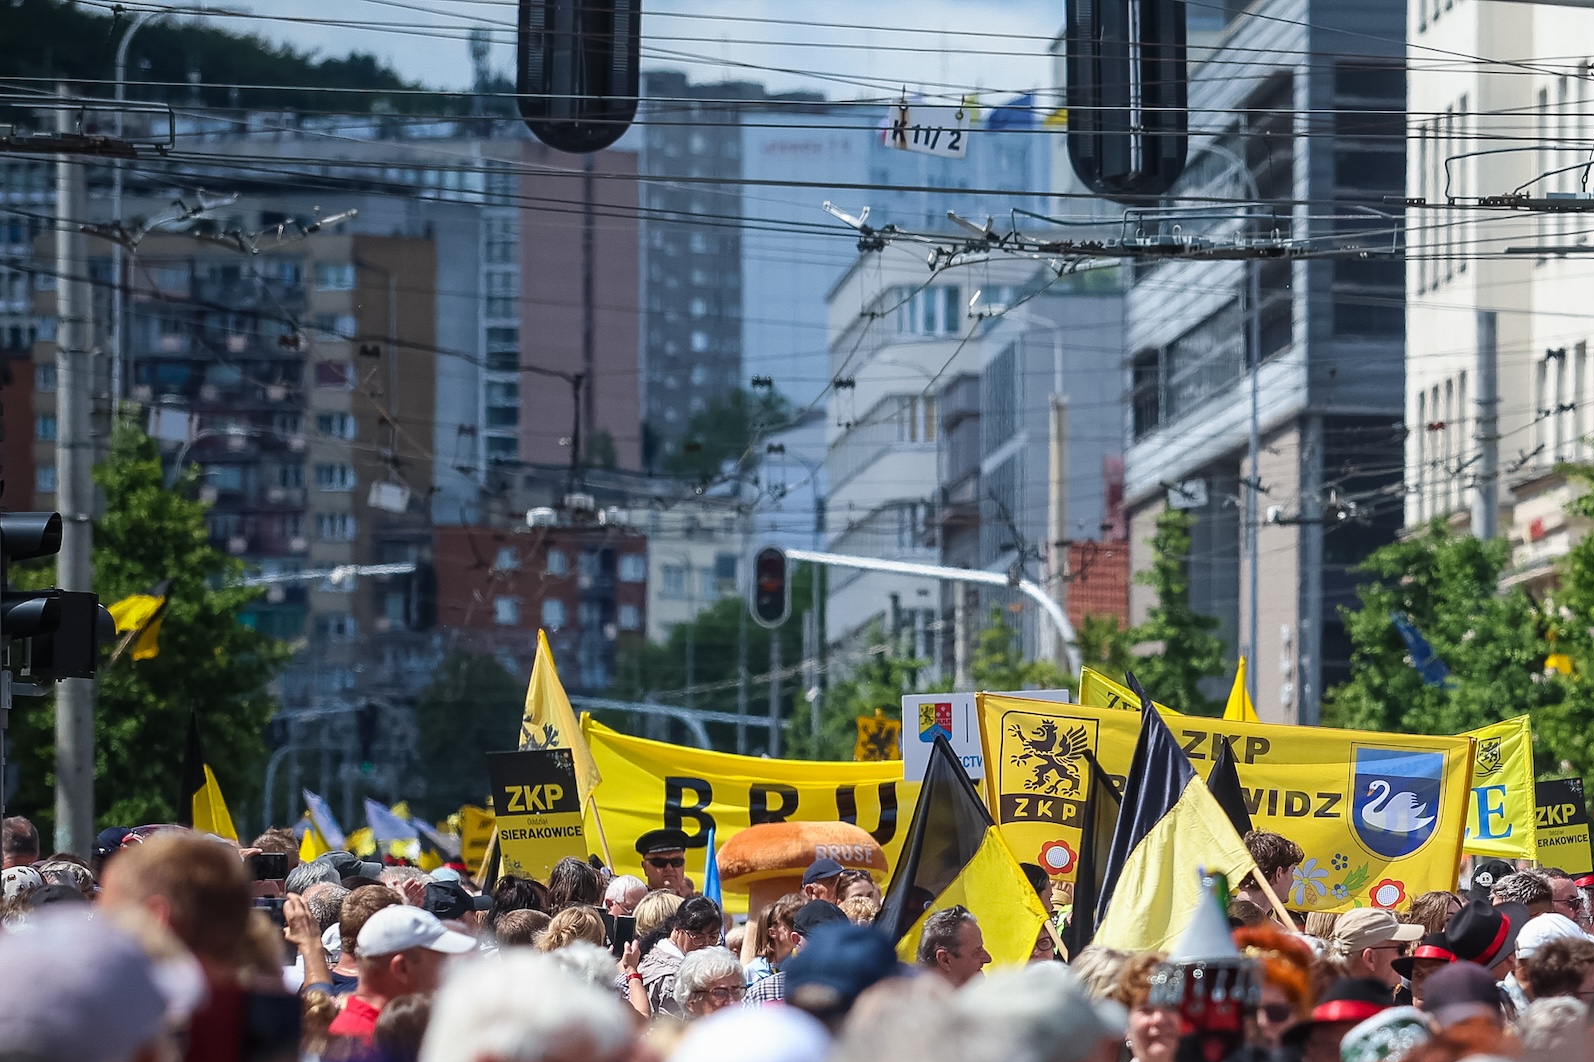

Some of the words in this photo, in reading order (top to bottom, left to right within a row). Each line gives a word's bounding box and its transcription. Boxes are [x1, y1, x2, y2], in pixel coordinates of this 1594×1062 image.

[1181, 729, 1271, 765] ZKP
[505, 784, 564, 812] ZKP
[1014, 798, 1077, 821] ZKP
[1535, 803, 1576, 827] ZKP
[501, 826, 583, 840] SIERAKOWICE
[1537, 834, 1588, 847] ERAKOWICE
